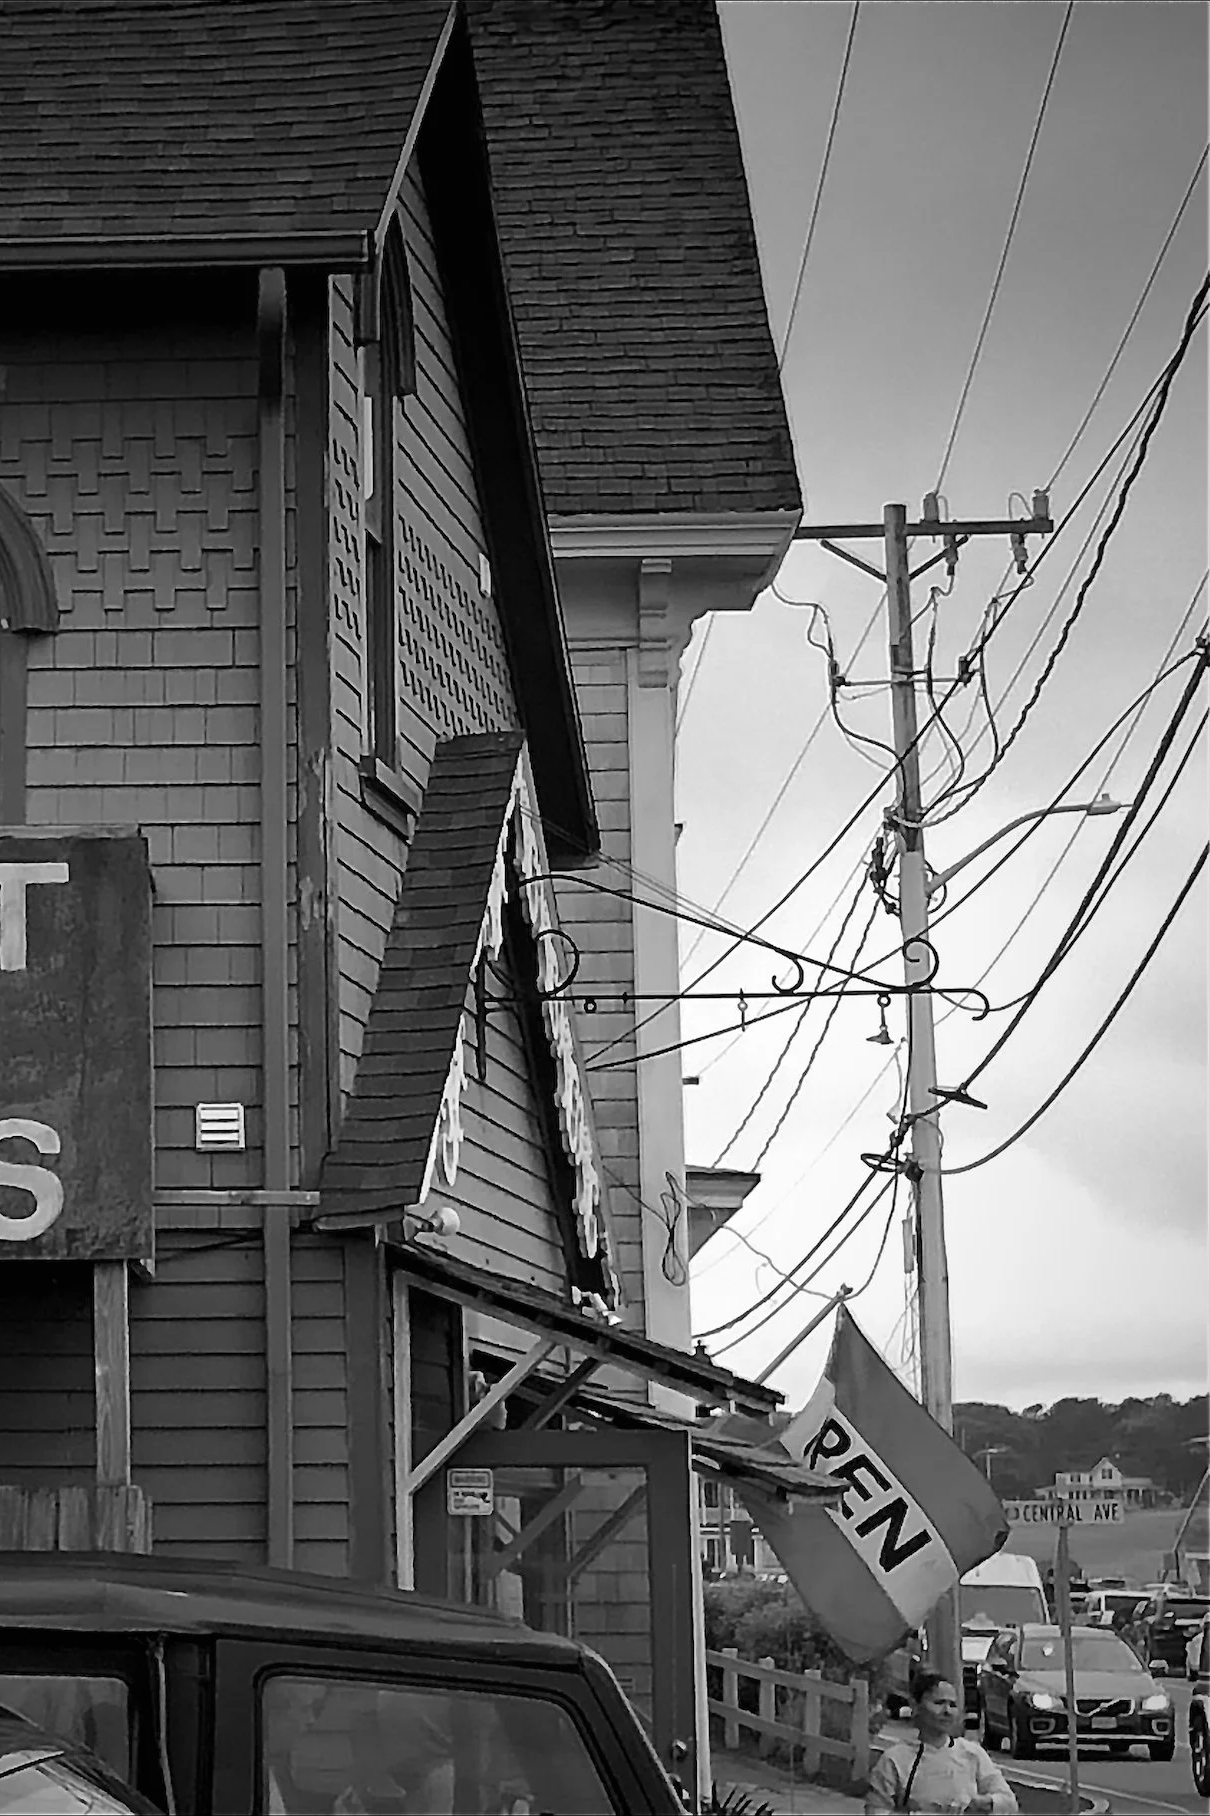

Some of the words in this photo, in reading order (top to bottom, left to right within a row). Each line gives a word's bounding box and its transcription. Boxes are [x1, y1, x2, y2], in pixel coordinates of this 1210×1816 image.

[803, 1417, 932, 1572] PEN
[1023, 1504, 1083, 1522] CENTRAL
[1094, 1503, 1119, 1521] AVE
